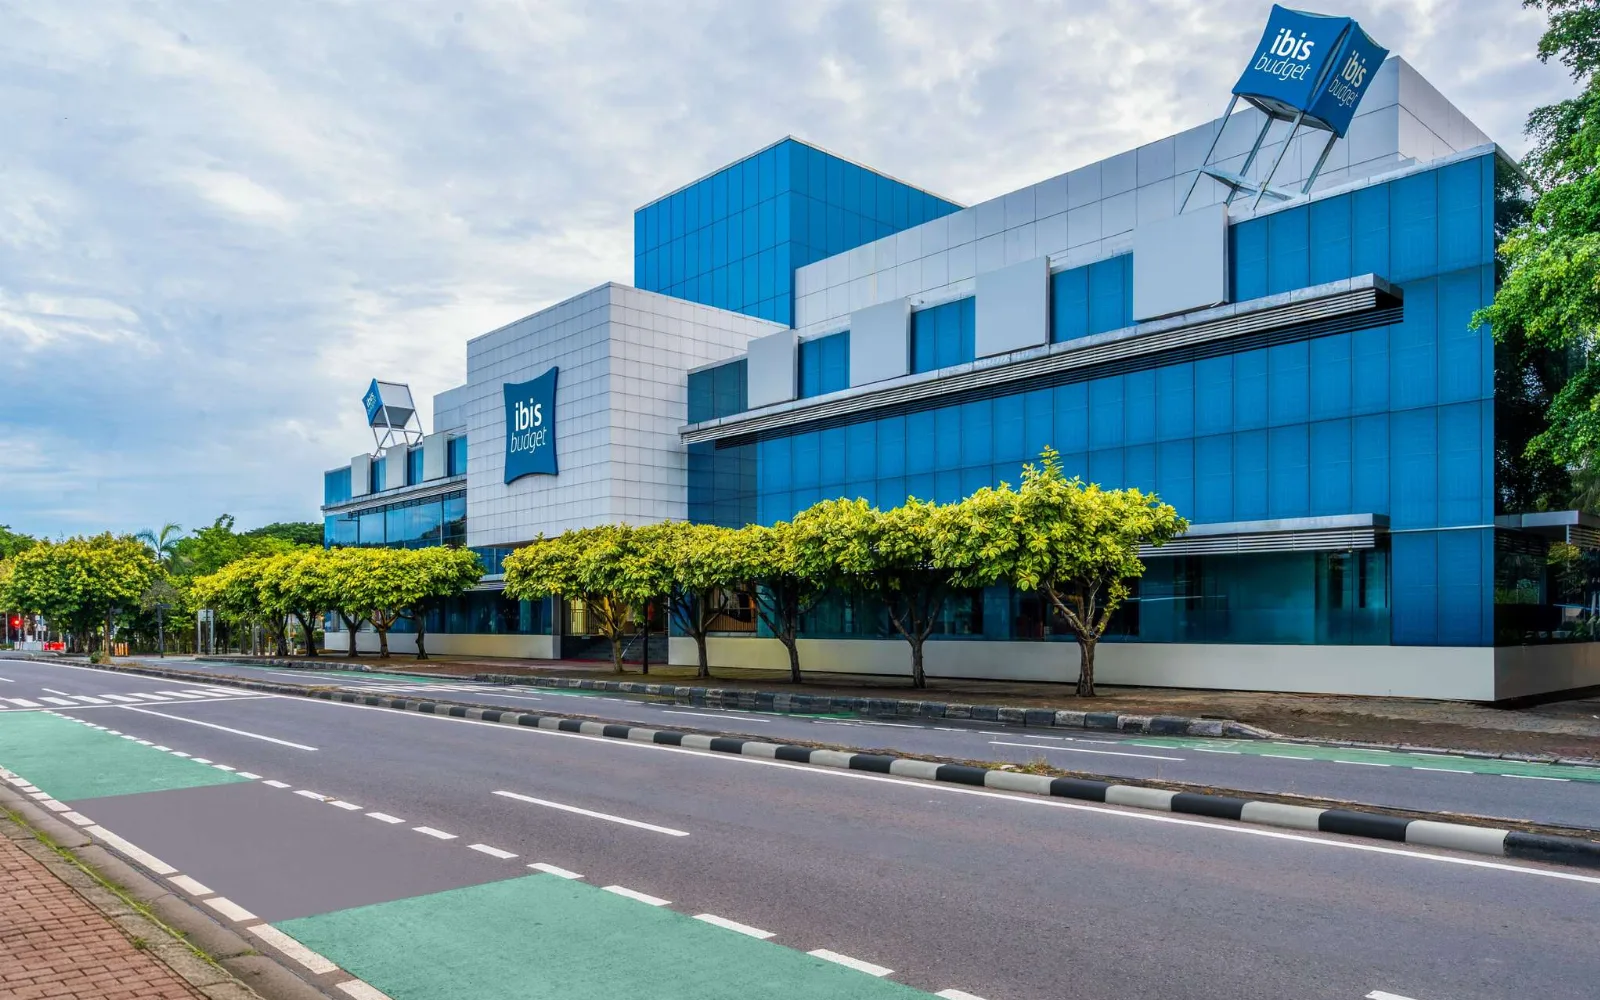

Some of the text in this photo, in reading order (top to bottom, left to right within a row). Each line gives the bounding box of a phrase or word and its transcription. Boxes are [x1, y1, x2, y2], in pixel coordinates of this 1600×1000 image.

[1270, 28, 1315, 61] ibis
[1254, 52, 1311, 81] budget
[1341, 50, 1367, 88] ibis
[1328, 74, 1359, 108] budget
[515, 397, 542, 431] ibis
[510, 426, 547, 453] budget
